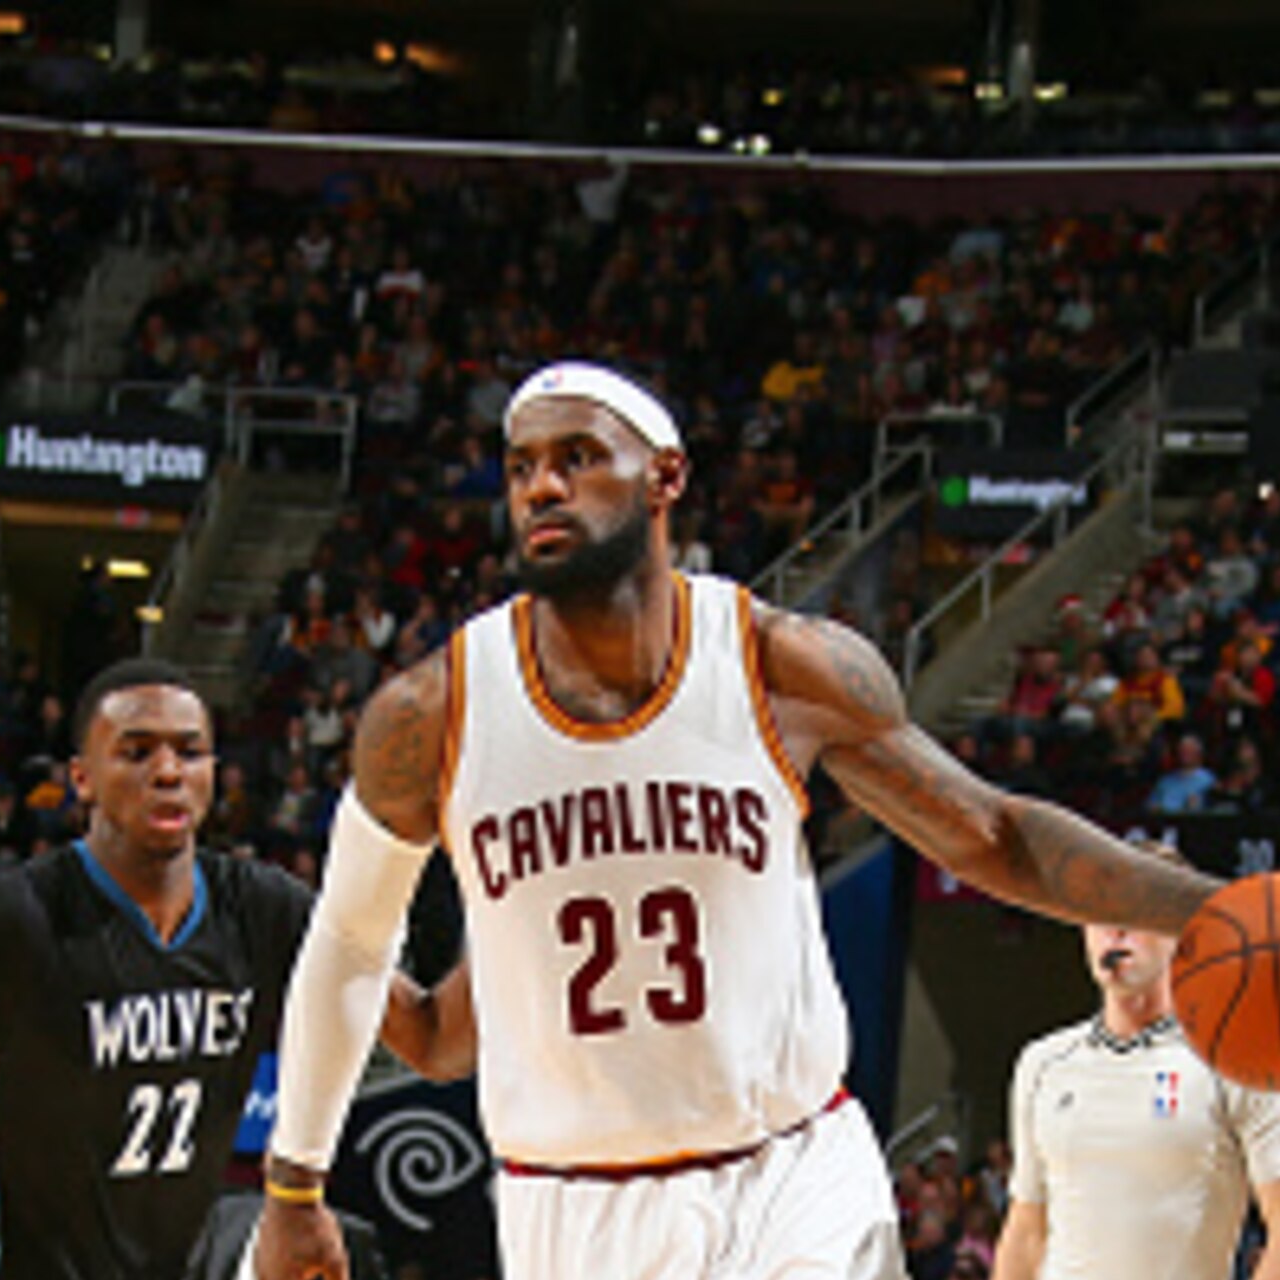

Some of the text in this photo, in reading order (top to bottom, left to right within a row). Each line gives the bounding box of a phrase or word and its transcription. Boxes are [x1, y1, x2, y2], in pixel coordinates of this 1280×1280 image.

[6, 424, 203, 488] Huntington
[471, 780, 769, 900] CAVALIERS
[558, 884, 706, 1035] 23
[84, 985, 254, 1069] WOLVES
[108, 1076, 201, 1179] 22
